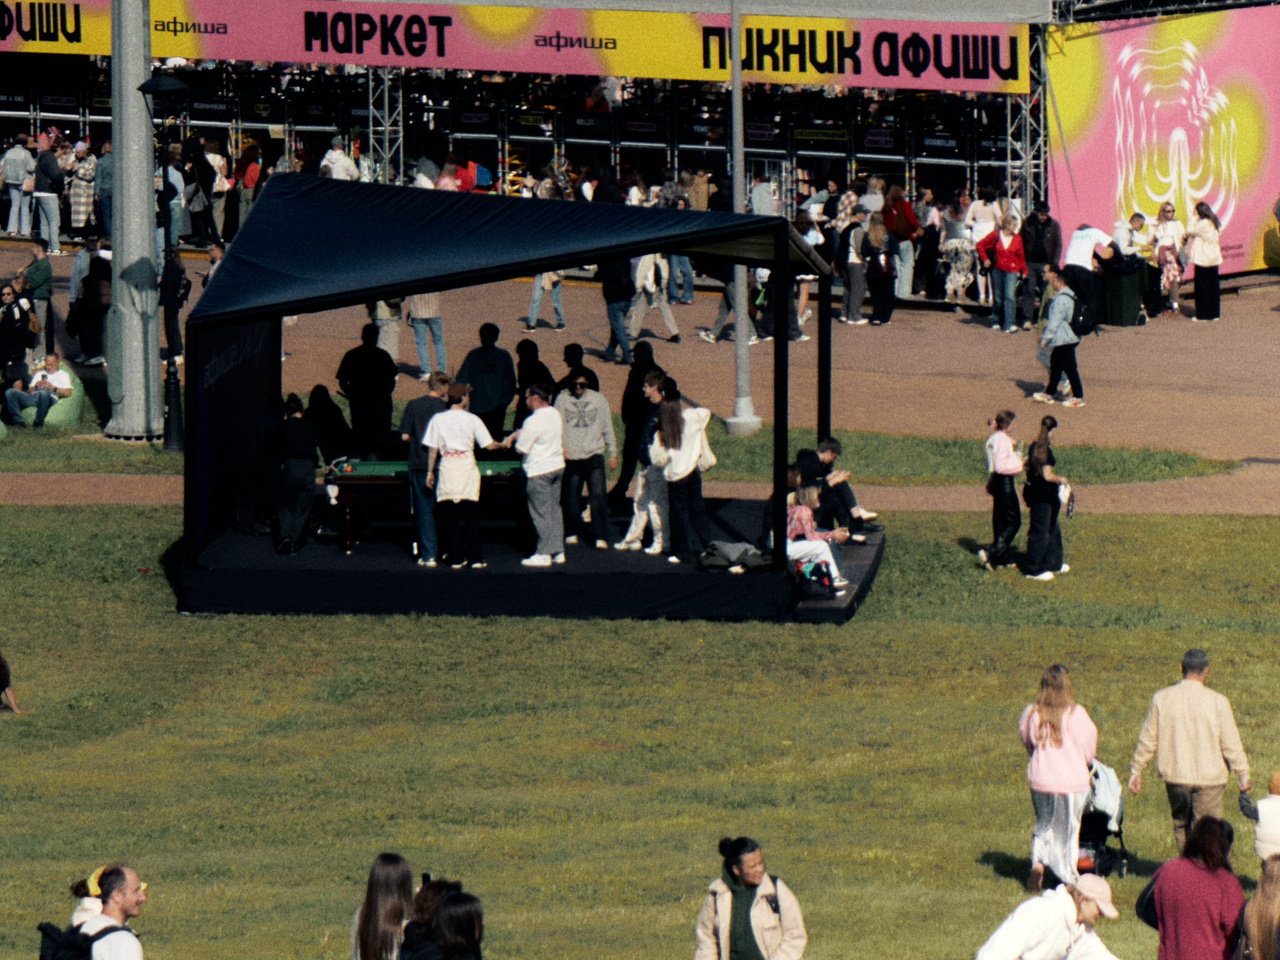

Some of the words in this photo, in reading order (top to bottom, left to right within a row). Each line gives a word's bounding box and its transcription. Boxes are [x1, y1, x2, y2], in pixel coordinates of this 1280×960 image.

[154, 16, 228, 36] афиша
[534, 31, 618, 52] афиша
[702, 26, 862, 75] ПИКНИК
[872, 31, 1019, 81] АФИШИ
